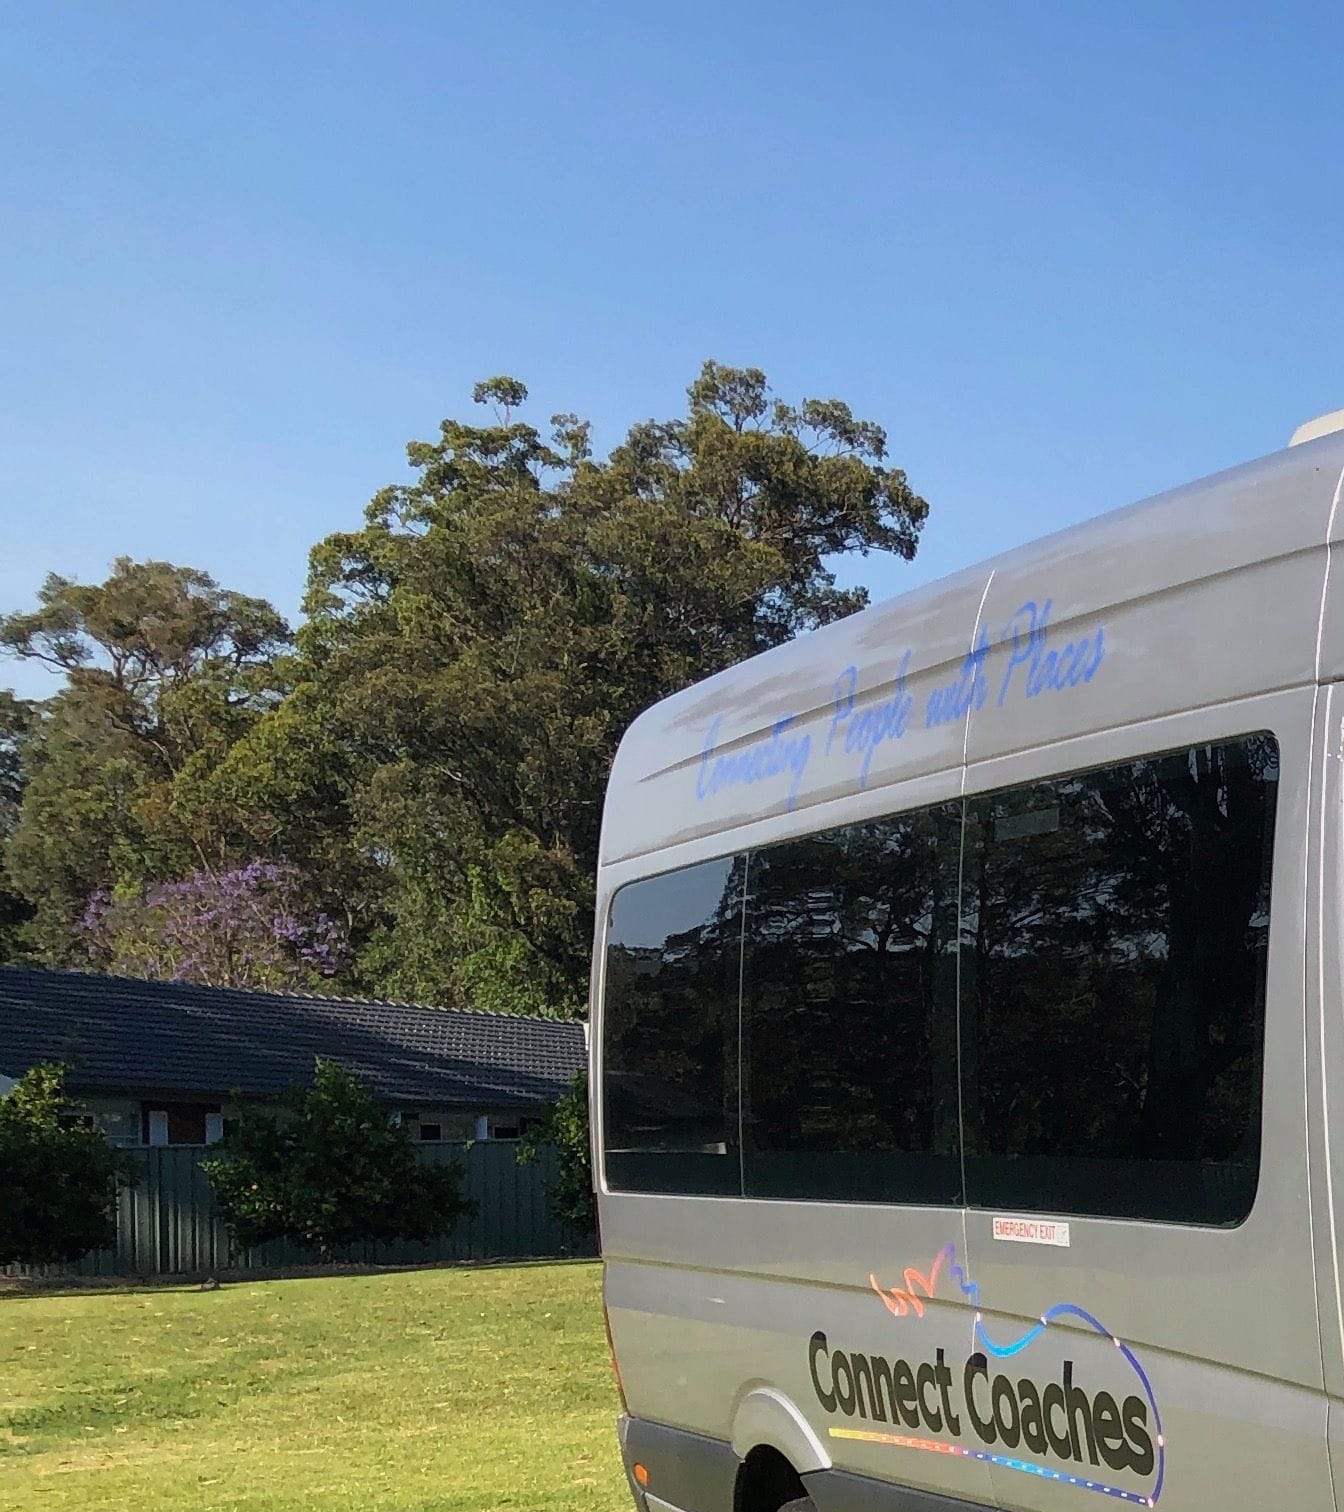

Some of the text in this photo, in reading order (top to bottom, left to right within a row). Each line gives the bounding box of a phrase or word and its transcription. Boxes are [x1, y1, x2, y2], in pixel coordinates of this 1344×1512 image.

[826, 649, 913, 789] People
[998, 597, 1105, 707] Places
[995, 1221, 1056, 1240] EMERGENCY EXIT
[809, 1330, 1154, 1476] Connect Coaches
